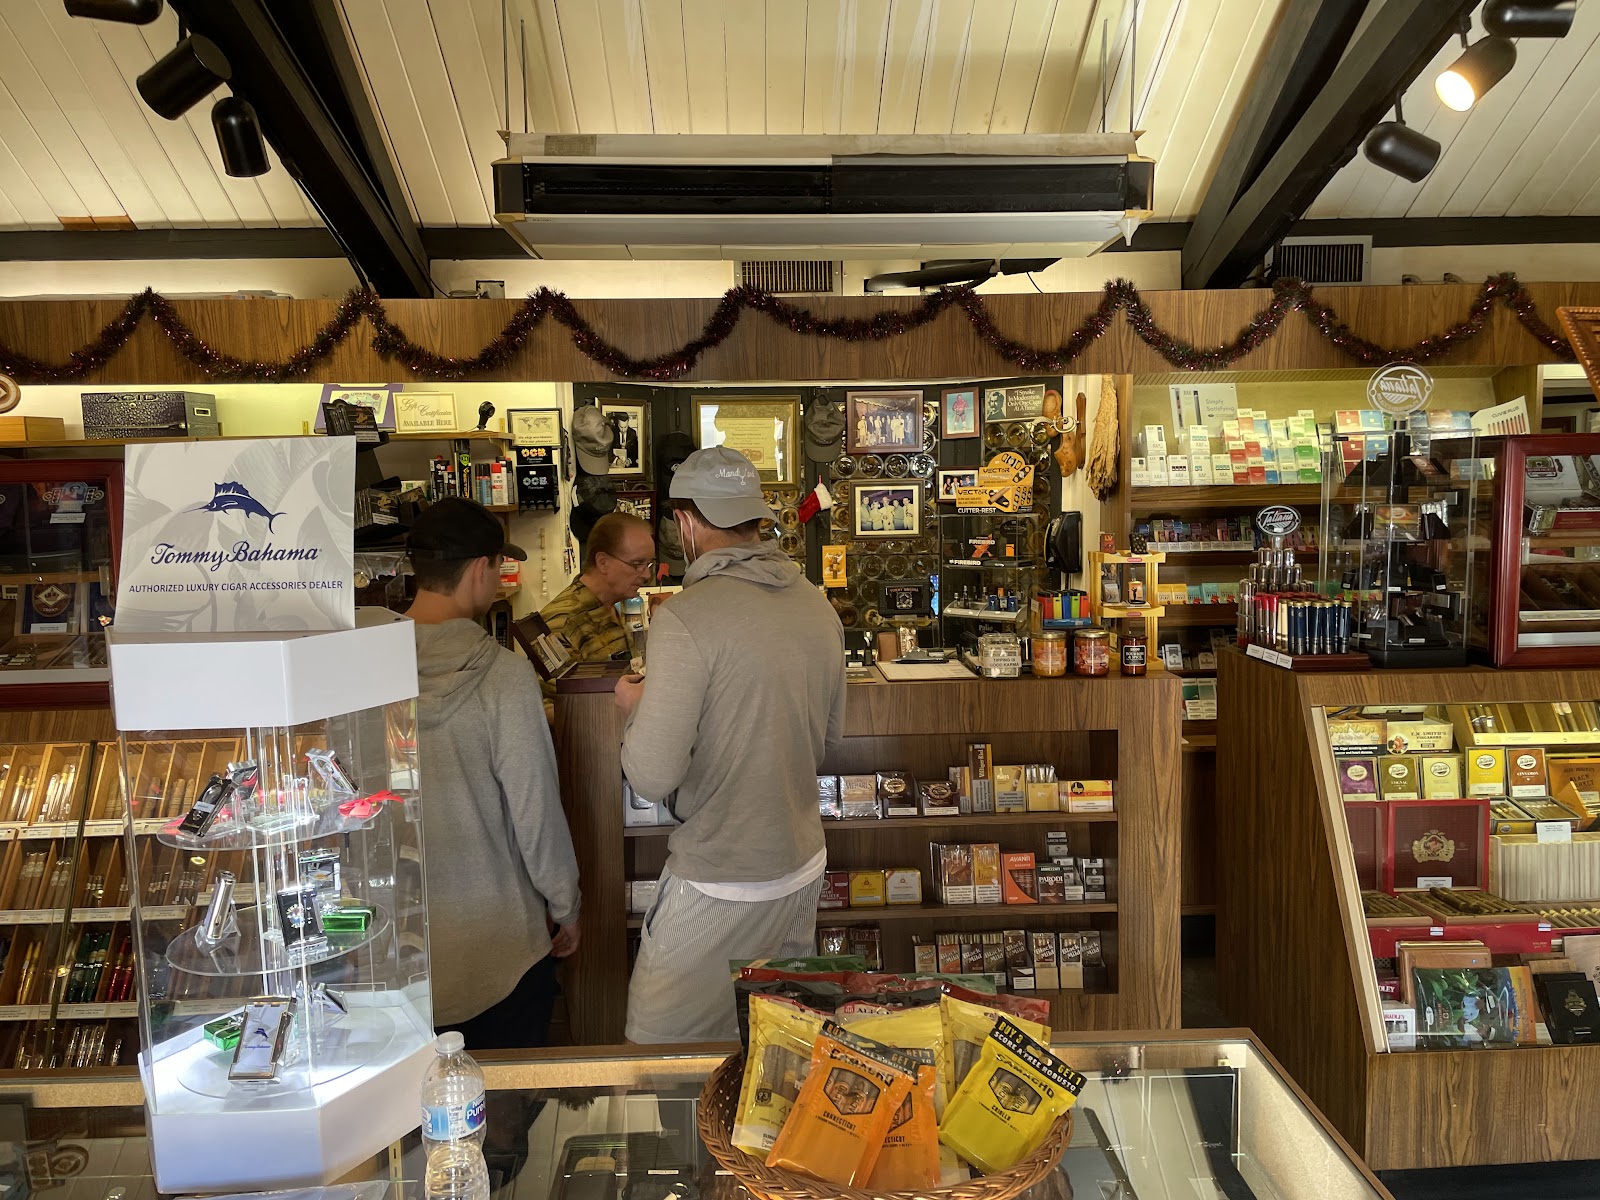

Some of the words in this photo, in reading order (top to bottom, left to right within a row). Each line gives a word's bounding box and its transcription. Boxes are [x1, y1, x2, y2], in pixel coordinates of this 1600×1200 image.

[106, 394, 158, 402] ACID
[400, 398, 418, 412] Gift
[521, 448, 546, 457] OCB
[523, 477, 548, 486] OCB
[1262, 510, 1294, 527] Tatiana
[150, 543, 228, 572] Tommy
[225, 540, 319, 564] Bahama
[129, 584, 184, 594] AUTHORIZED
[186, 583, 220, 592] LUXURY
[221, 582, 247, 591] CIGAR
[249, 581, 307, 591] ACCESSORIES
[309, 580, 343, 589] DEALER
[962, 948, 981, 958] Black
[984, 948, 1002, 958] Black
[1036, 944, 1053, 955] Black
[1042, 950, 1054, 958] Mild
[1062, 944, 1079, 954] Black
[1068, 950, 1080, 959] Mild
[969, 954, 982, 963] Mild
[826, 1024, 844, 1037] BUY
[892, 1054, 907, 1066] GET
[911, 1061, 917, 1069] 1
[998, 1022, 1016, 1038] BUY
[1016, 1034, 1023, 1043] 3
[1058, 1064, 1075, 1080] GET
[926, 1049, 930, 1058] 1
[994, 1031, 1017, 1051] SCORE
[1023, 1052, 1042, 1068] FREE
[1042, 1066, 1076, 1092] ROBUSTO
[830, 1048, 894, 1087] CAMACHO
[996, 1054, 1054, 1098] CAMACHO
[823, 1111, 856, 1131] CONNECTICUT
